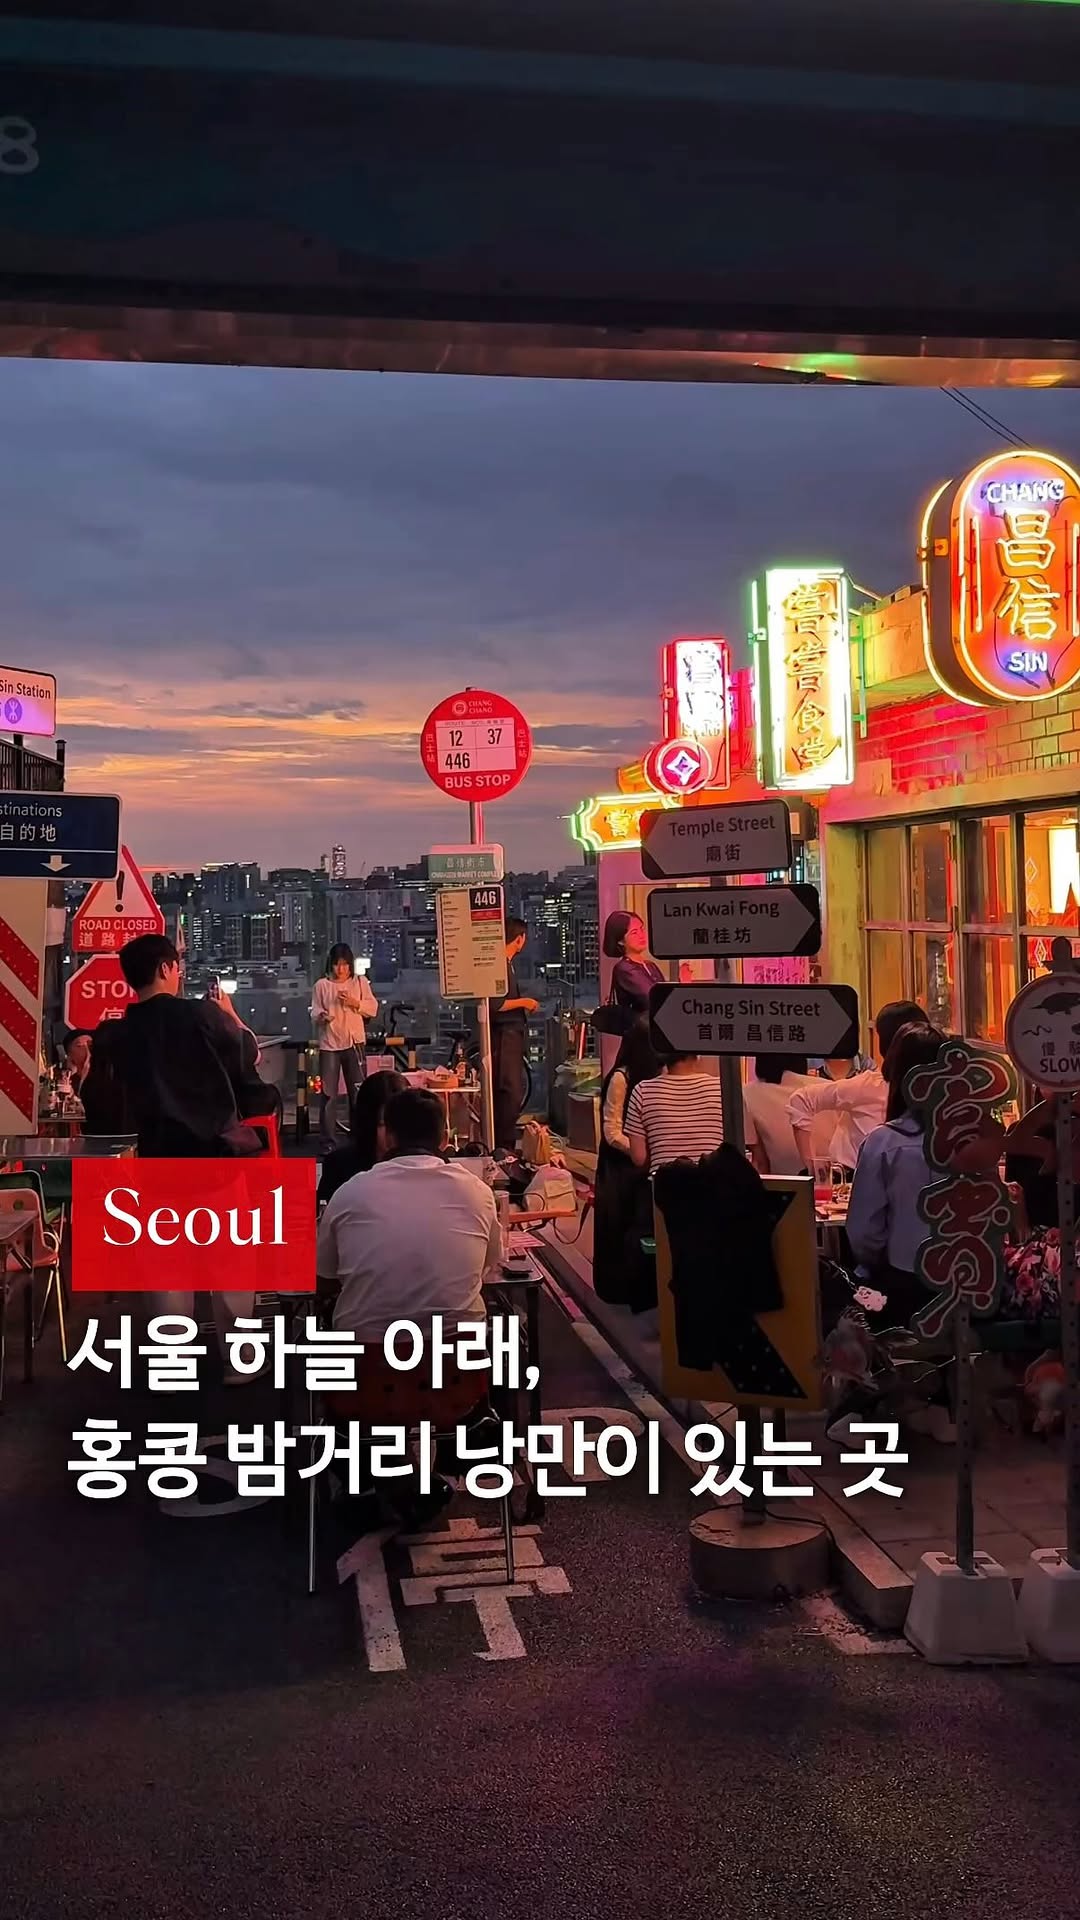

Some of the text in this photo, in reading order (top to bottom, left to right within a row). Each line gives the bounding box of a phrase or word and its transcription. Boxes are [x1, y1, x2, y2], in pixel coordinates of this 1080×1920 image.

[986, 479, 1065, 502] CHANG
[997, 507, 1060, 640] 昌信
[1008, 652, 1048, 673] SIN
[0, 679, 51, 700] Sin Station
[449, 730, 463, 747] 12
[487, 728, 503, 745] 37
[445, 752, 470, 770] 446
[444, 774, 511, 789] BUS STOP
[669, 815, 776, 839] Temple Street
[705, 843, 741, 863] 廟街
[474, 890, 497, 906] 446
[663, 900, 780, 919] Lan Kwai Fong
[79, 919, 157, 931] ROAD CLOSED
[693, 927, 752, 945] 蘭桂坊
[681, 999, 821, 1020] Chang Sin Street
[697, 1023, 806, 1042] 首爾 昌信路
[1040, 1057, 1080, 1073] SLOW
